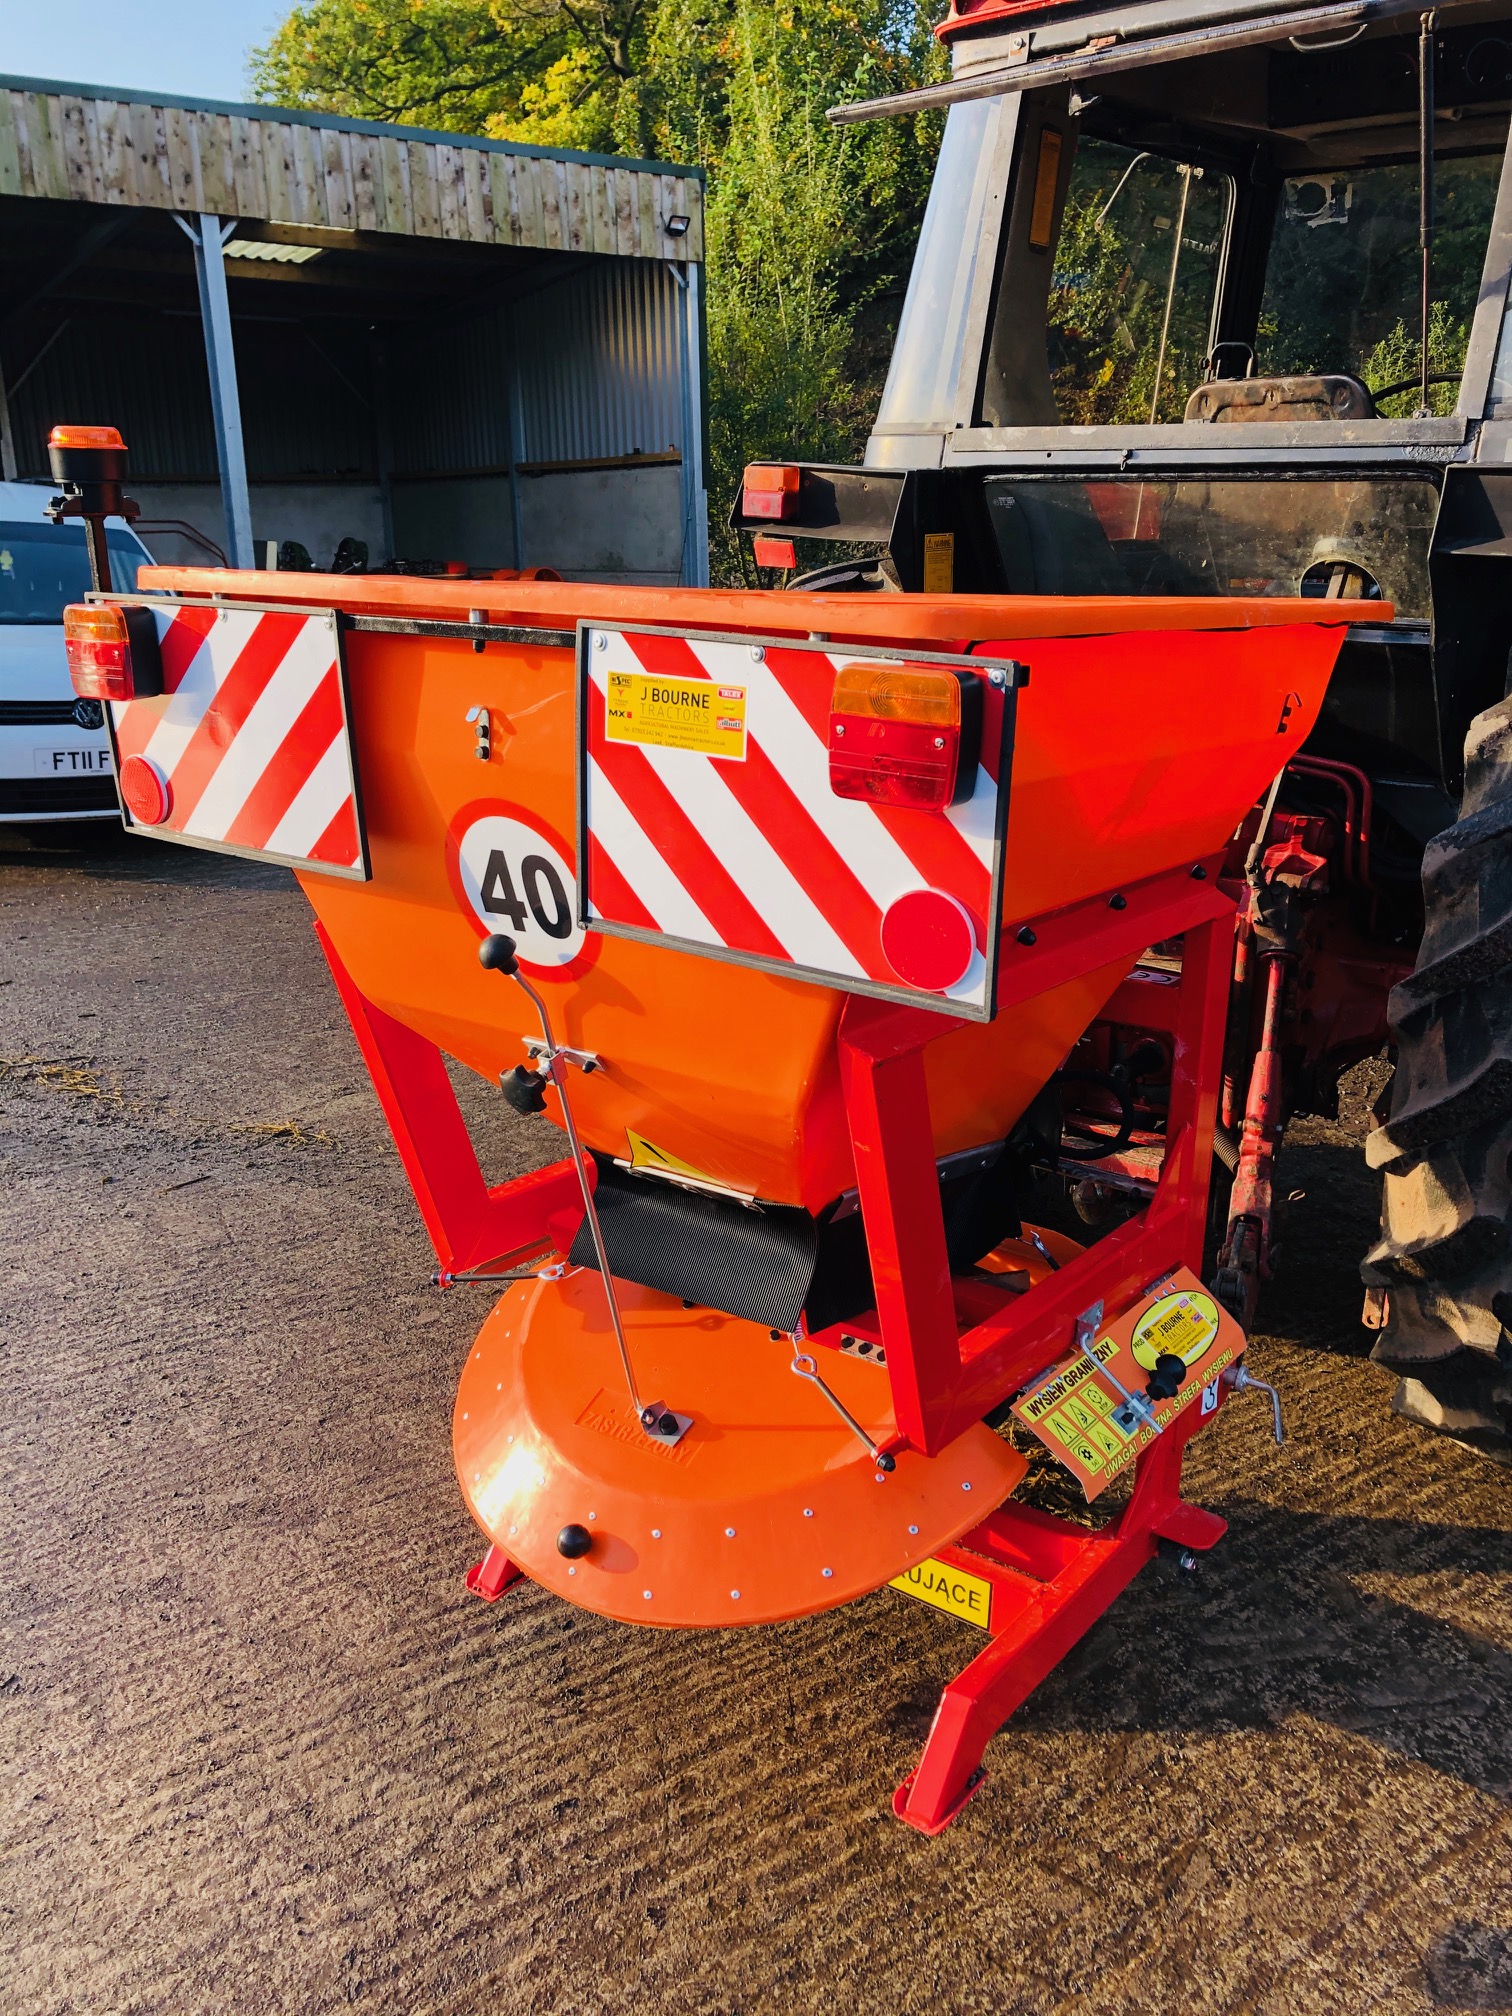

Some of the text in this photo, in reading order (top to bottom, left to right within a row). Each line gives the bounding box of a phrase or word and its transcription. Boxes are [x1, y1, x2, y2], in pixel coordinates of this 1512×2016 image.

[640, 686, 710, 709] J BOURNE
[608, 709, 626, 718] MX
[640, 702, 710, 724] TRACTORS
[480, 848, 572, 939] 40
[1157, 1327, 1165, 1337] J
[1160, 1310, 1186, 1333] BOURNE
[1164, 1321, 1192, 1343] TRACTORS
[1026, 1381, 1067, 1417] WYSIEW
[1103, 1347, 1235, 1479] UWAGA! BOZNA STREFA WYSIEWU
[900, 1567, 982, 1612] UJĄCE
